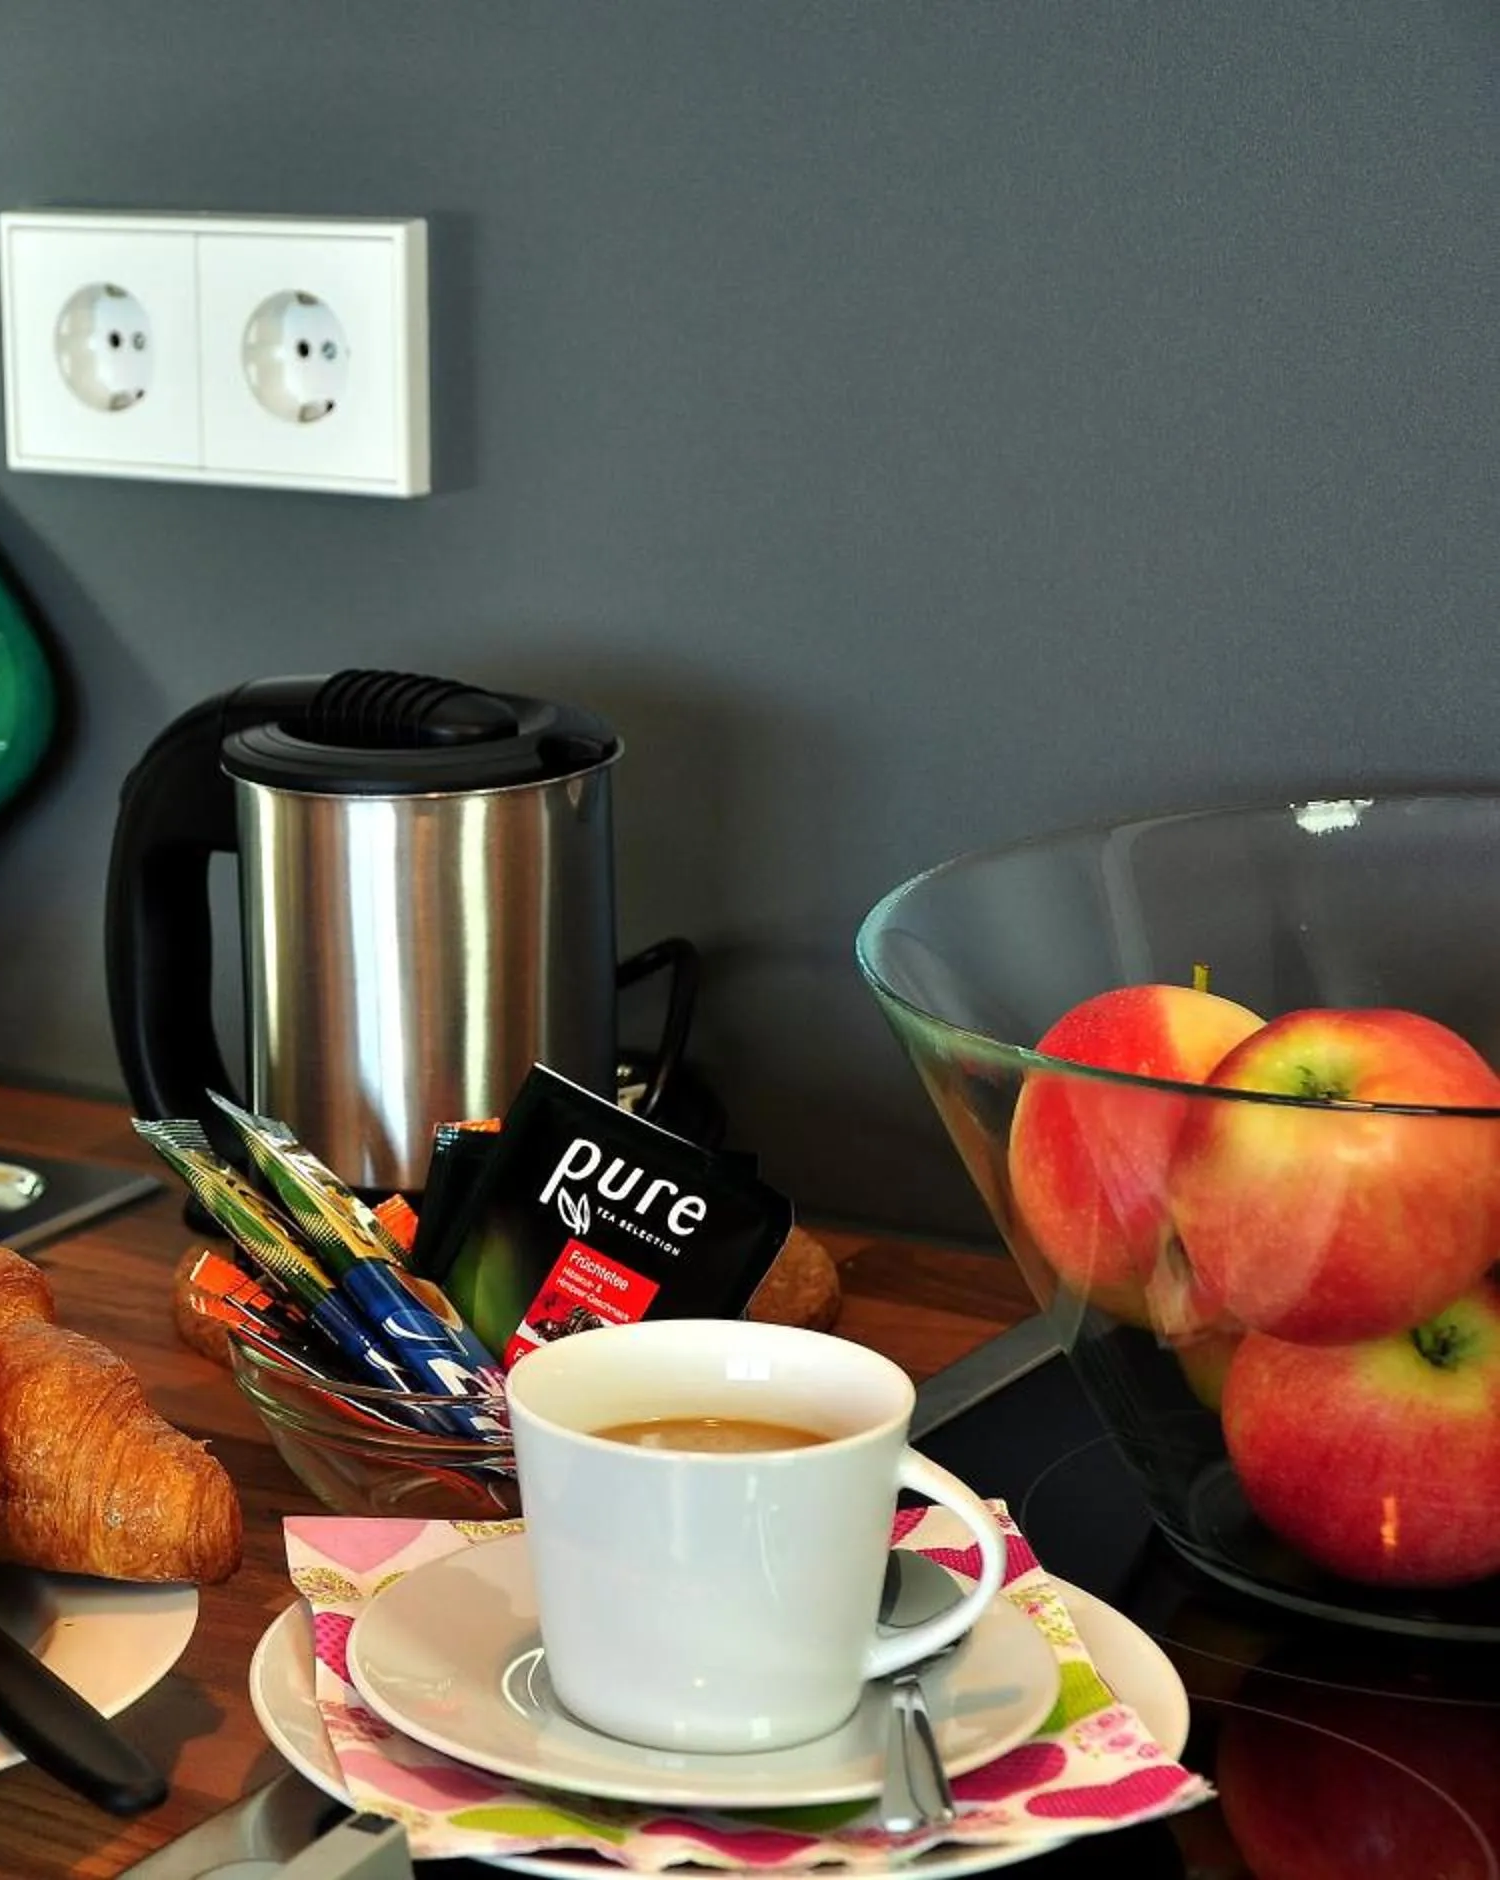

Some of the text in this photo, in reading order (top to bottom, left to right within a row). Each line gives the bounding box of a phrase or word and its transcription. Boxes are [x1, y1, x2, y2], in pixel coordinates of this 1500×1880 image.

[539, 1138, 707, 1236] pure
[596, 1206, 681, 1256] TEA SELECTION
